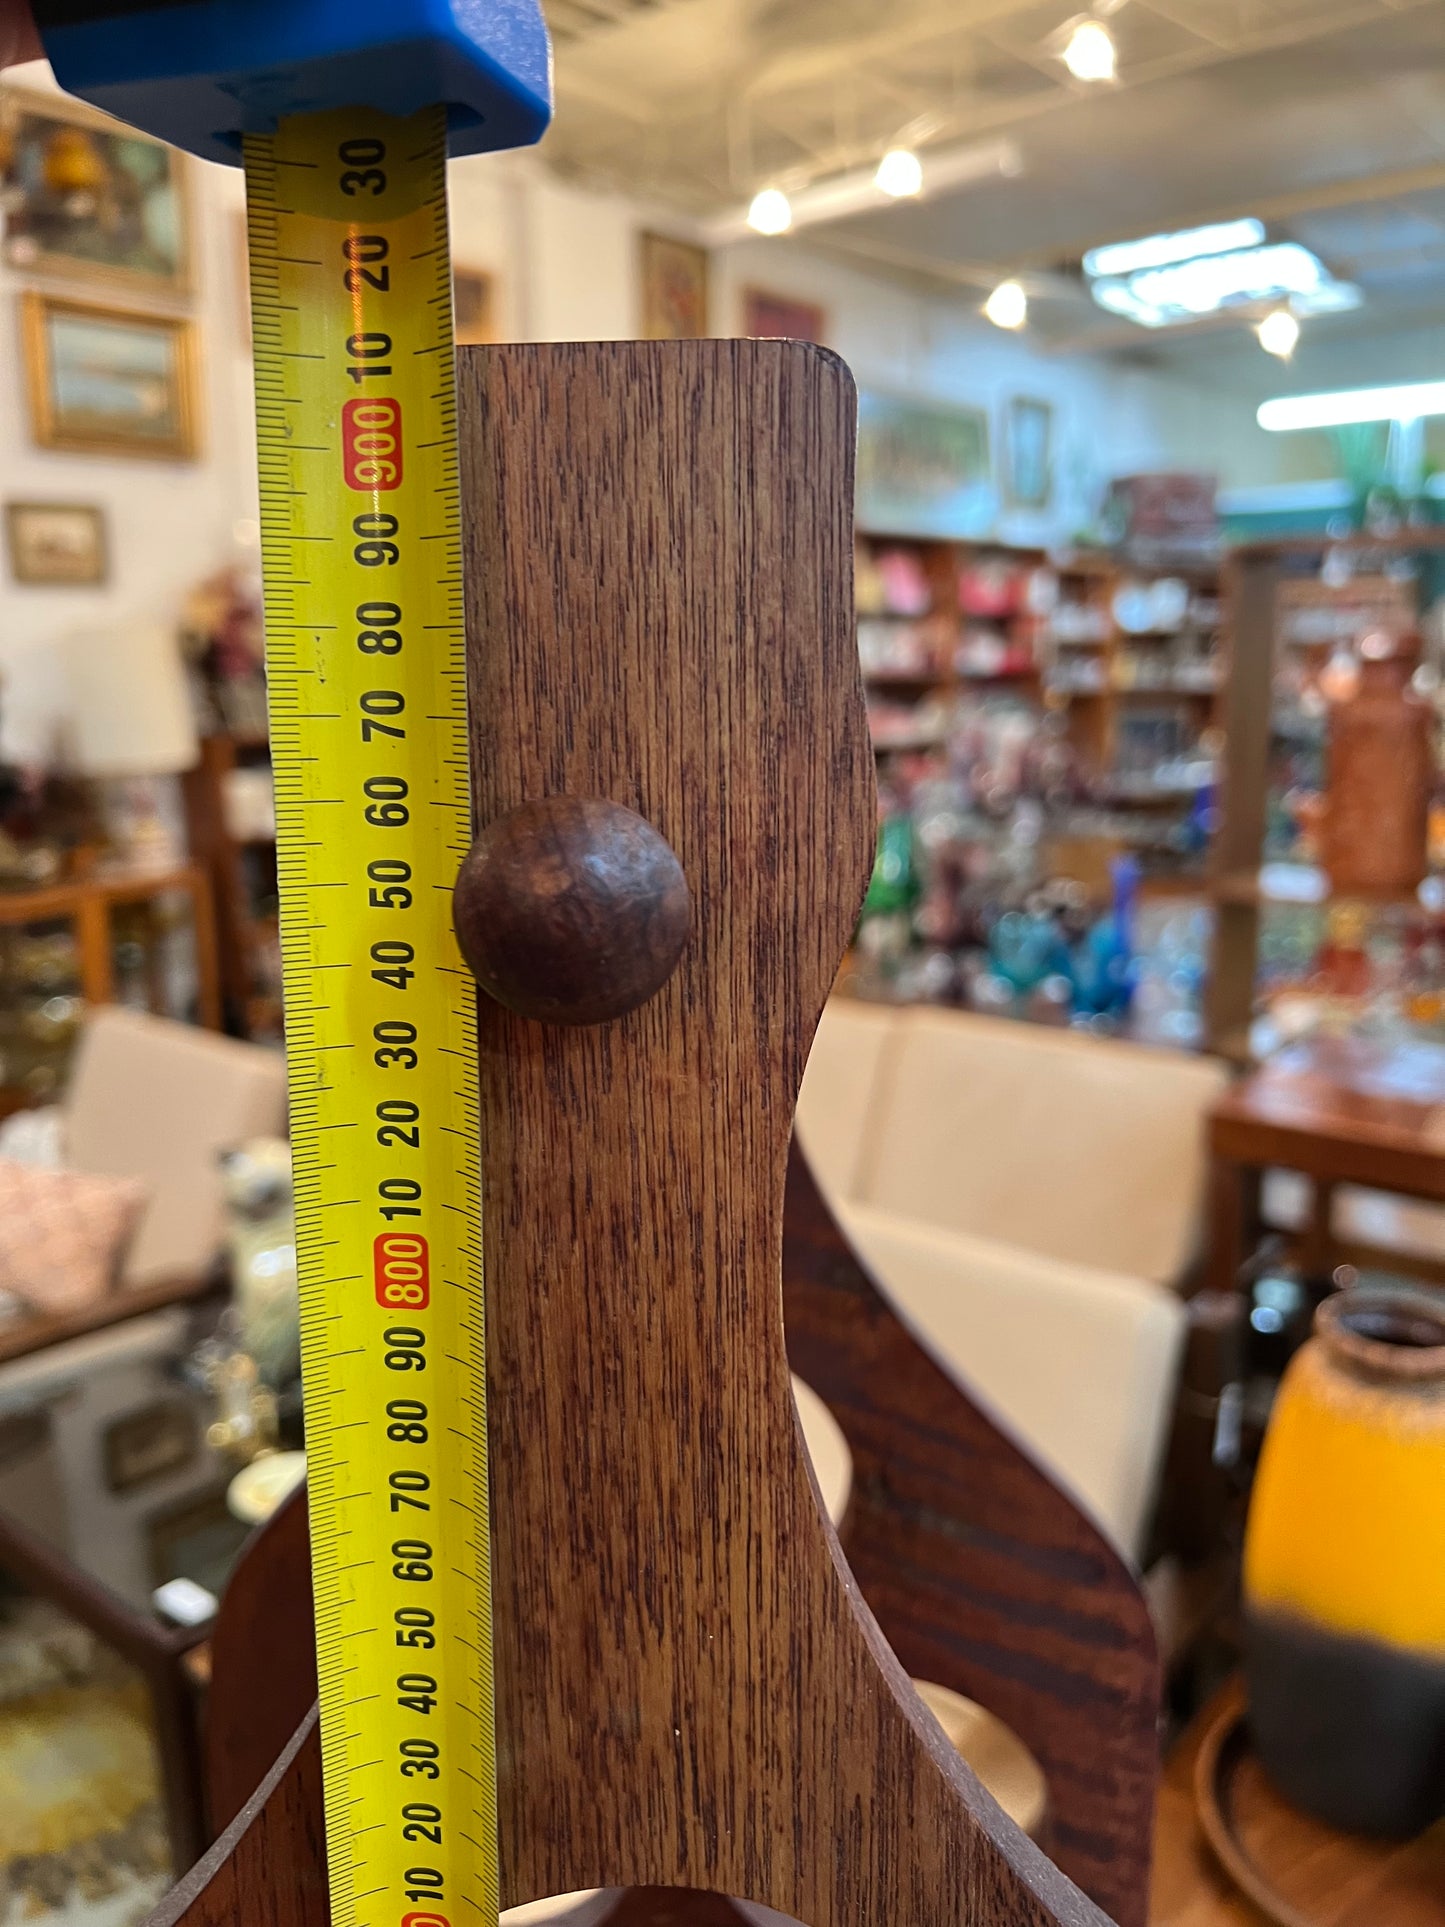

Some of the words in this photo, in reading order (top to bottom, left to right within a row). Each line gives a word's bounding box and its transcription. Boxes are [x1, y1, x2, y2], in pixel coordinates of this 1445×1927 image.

[339, 138, 387, 196] 30
[343, 234, 390, 292] 20
[346, 333, 392, 383] 10
[353, 406, 396, 484] 900
[353, 514, 399, 566] 90
[357, 602, 402, 655] 80
[360, 691, 405, 742] 70
[364, 777, 409, 826] 60
[367, 860, 412, 909] 50
[371, 941, 414, 989] 40
[374, 1021, 417, 1069] 30
[377, 1101, 419, 1148] 20
[379, 1179, 421, 1220] 10
[384, 1239, 424, 1304] 800
[384, 1327, 426, 1371] 90
[386, 1400, 428, 1443] 80
[389, 1471, 430, 1512] 70
[392, 1540, 433, 1581] 60
[395, 1608, 435, 1649] 50
[397, 1674, 437, 1714] 40
[400, 1739, 439, 1779] 30
[402, 1803, 441, 1844] 20
[405, 1868, 443, 1902] 10
